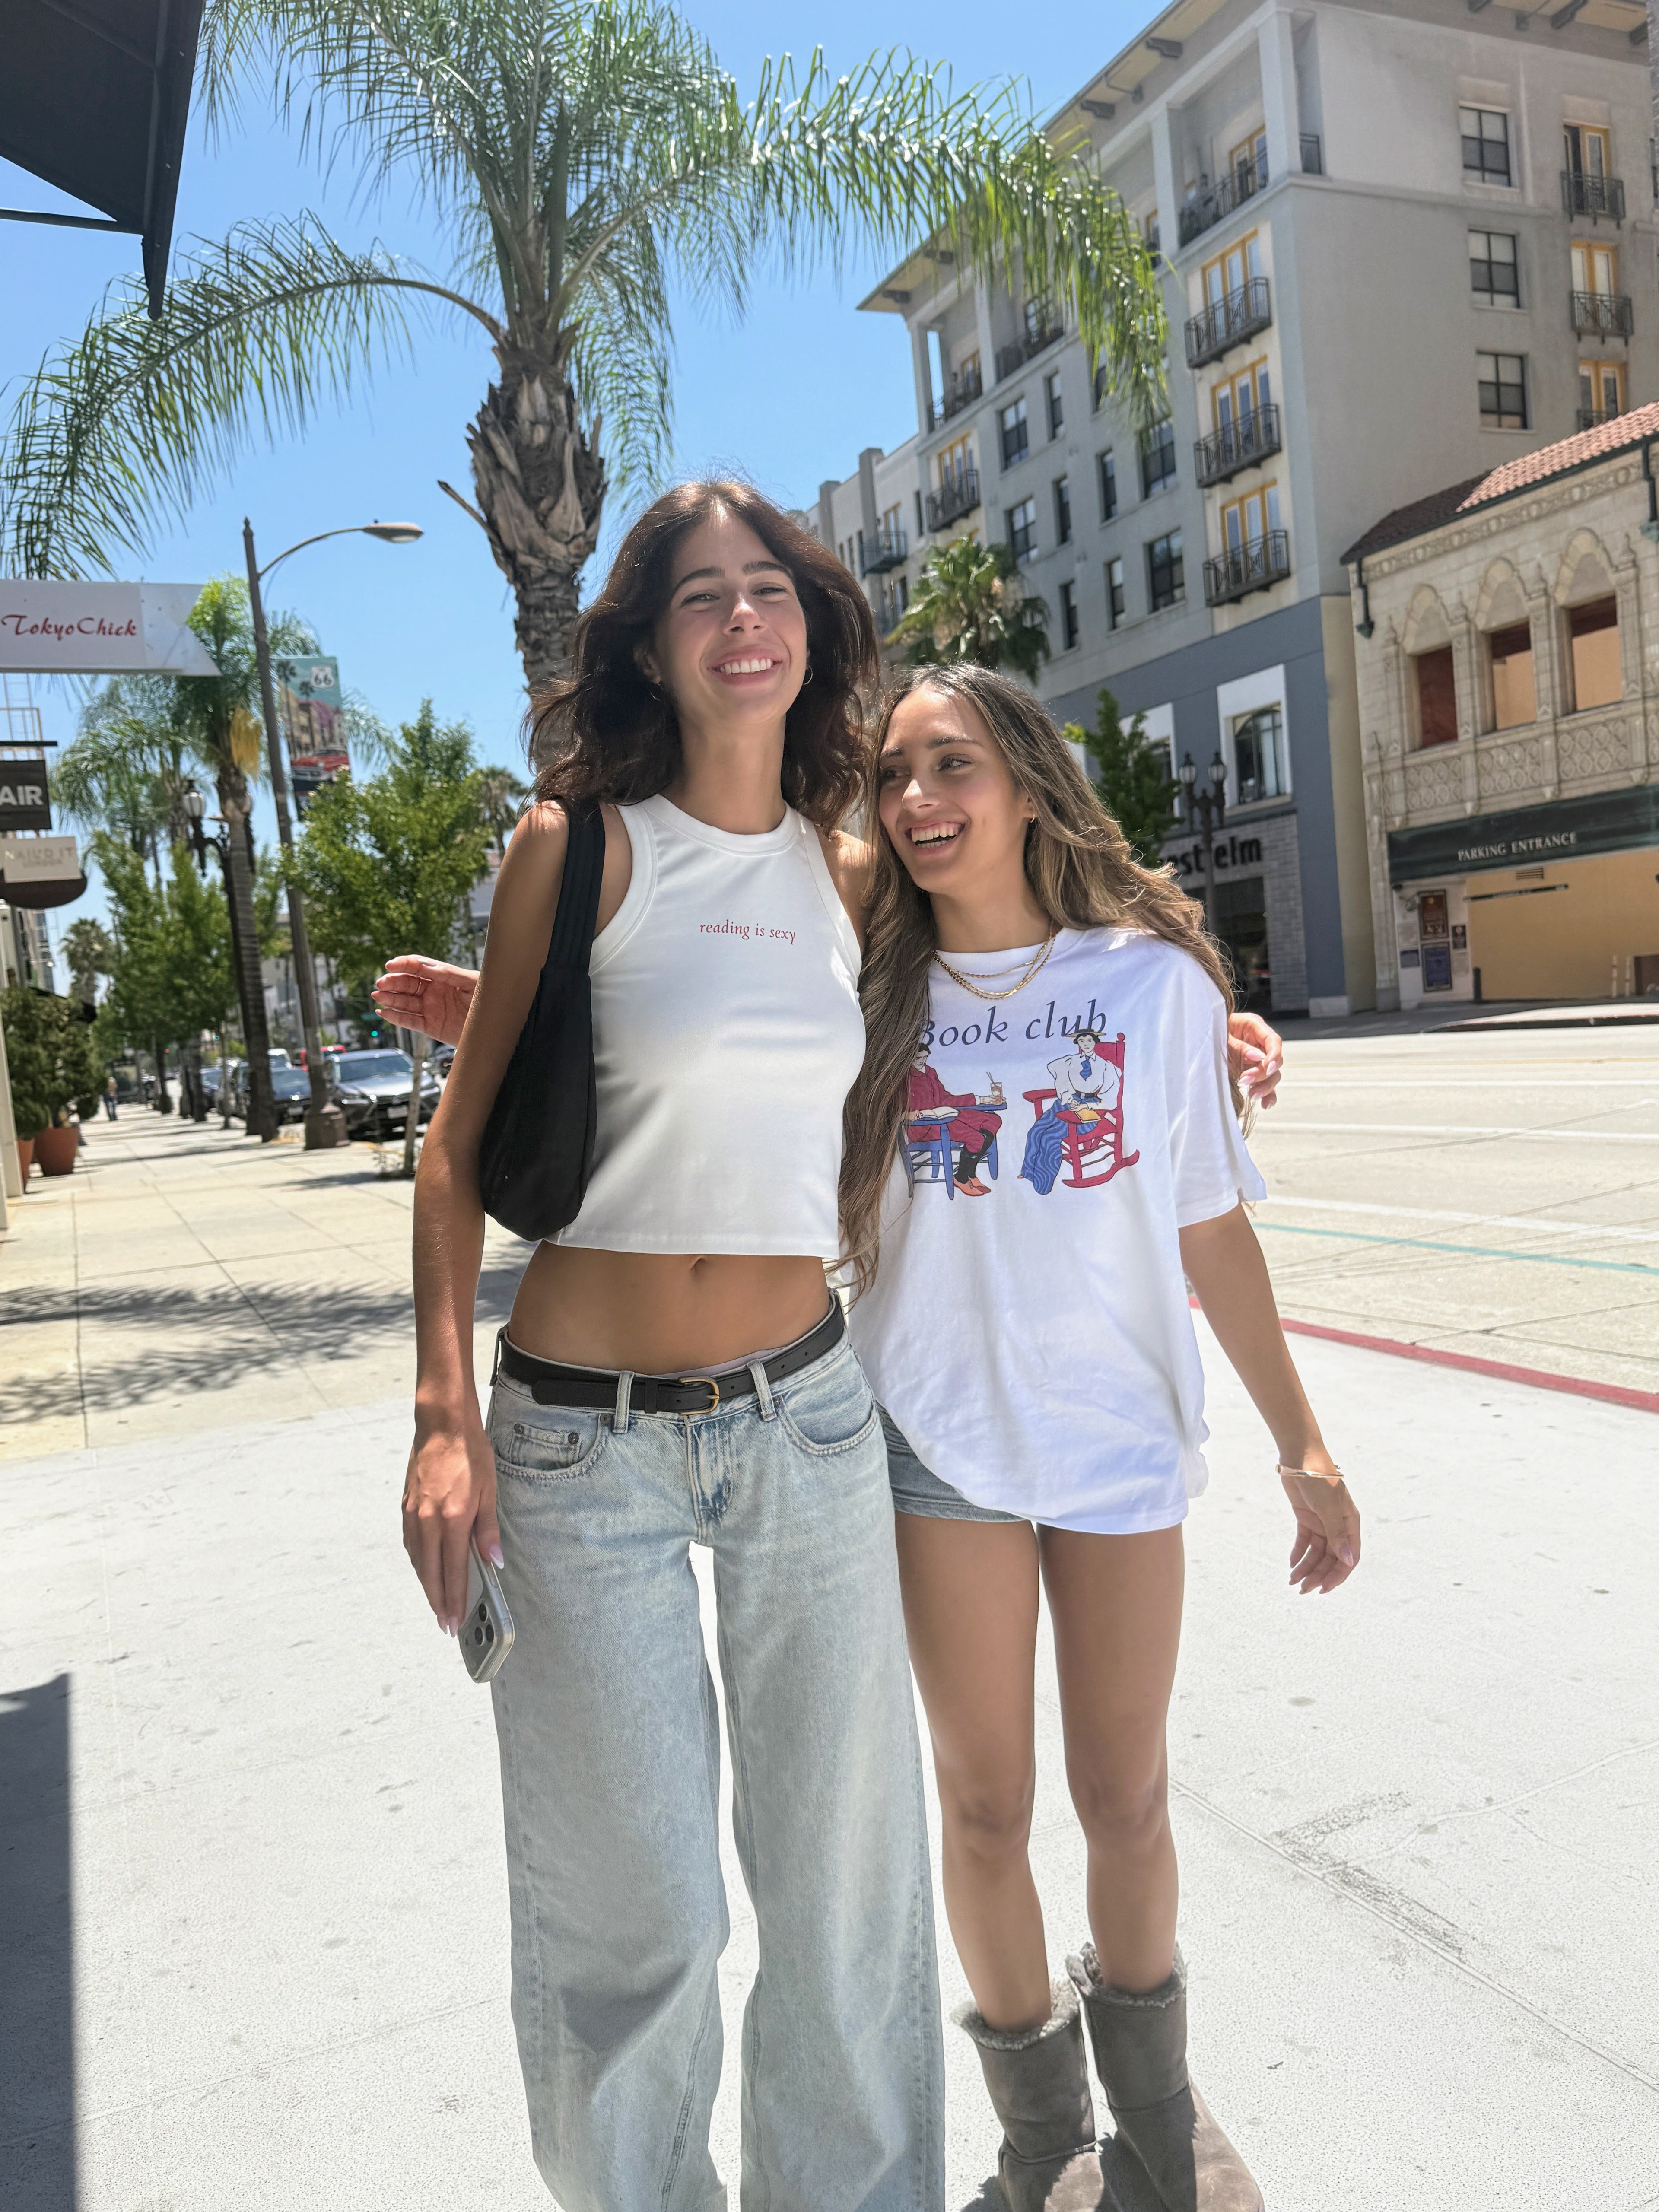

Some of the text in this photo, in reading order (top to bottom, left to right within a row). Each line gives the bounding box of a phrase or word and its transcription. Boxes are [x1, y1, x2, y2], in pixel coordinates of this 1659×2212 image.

[314, 674, 332, 686] 66
[1214, 836, 1262, 869] elm
[1458, 831, 1577, 862] PARKING ENTRANCE
[699, 919, 796, 945] reading is sexy
[1025, 999, 1106, 1039] club
